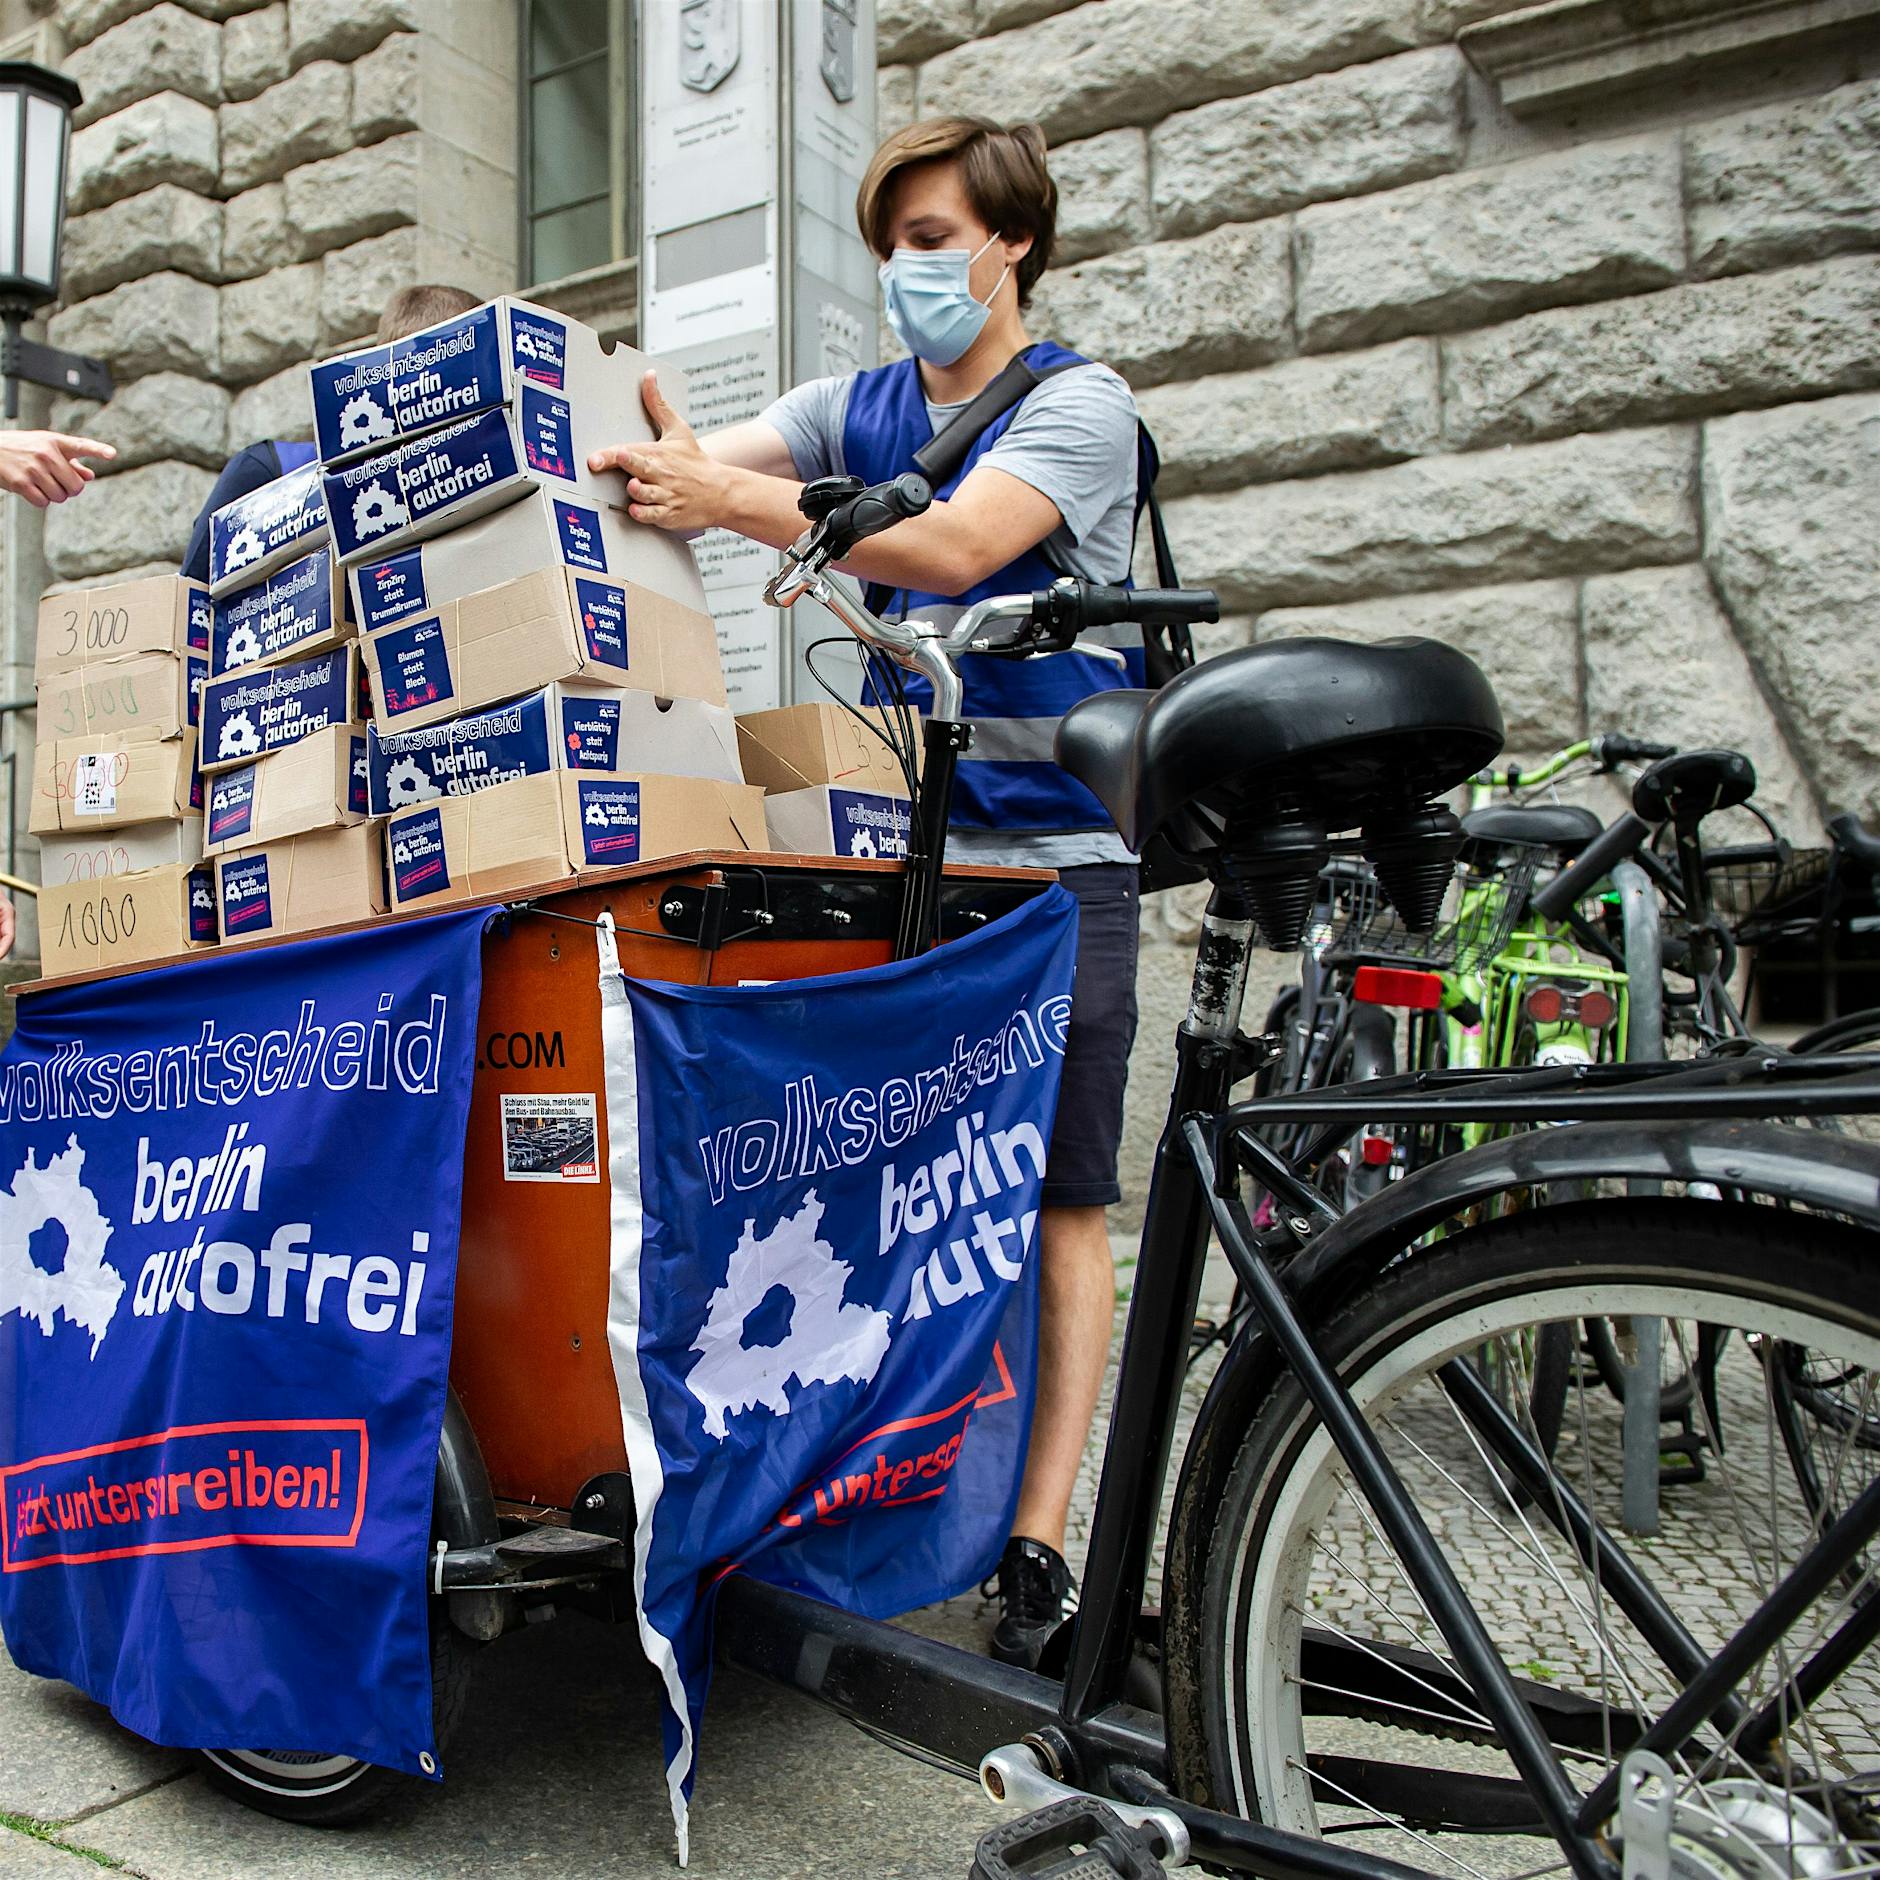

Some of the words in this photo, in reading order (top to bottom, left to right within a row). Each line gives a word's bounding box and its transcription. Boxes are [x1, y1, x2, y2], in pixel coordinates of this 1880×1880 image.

[334, 326, 476, 396] volksentscheid
[387, 370, 442, 407] berlin
[399, 378, 480, 426] autofrei
[396, 451, 452, 491] berlin
[413, 453, 494, 511] autofrei
[227, 564, 318, 624] volksentscheid
[377, 573, 406, 591] ZirpZirp
[384, 587, 404, 602] statt
[260, 602, 295, 634] berlin
[371, 597, 422, 621] BrummBrumm
[265, 608, 317, 650] autofrei
[397, 647, 425, 663] Blumen
[403, 661, 424, 676] statt
[220, 662, 331, 712] volksentscheid
[405, 674, 426, 690] Blech
[259, 697, 302, 726] berlin
[265, 707, 329, 744] autofrei
[378, 708, 522, 756] volksentscheid
[431, 745, 488, 776] berlin
[606, 803, 627, 814] berlin
[611, 814, 638, 825] autofrei
[409, 835, 429, 850] berlin
[413, 839, 441, 858] autofrei
[879, 831, 908, 855] berlin
[0, 993, 447, 1124] volksentscheid
[131, 1121, 267, 1225] berlin
[878, 1111, 1046, 1256] berlin
[133, 1223, 430, 1336] autofrei
